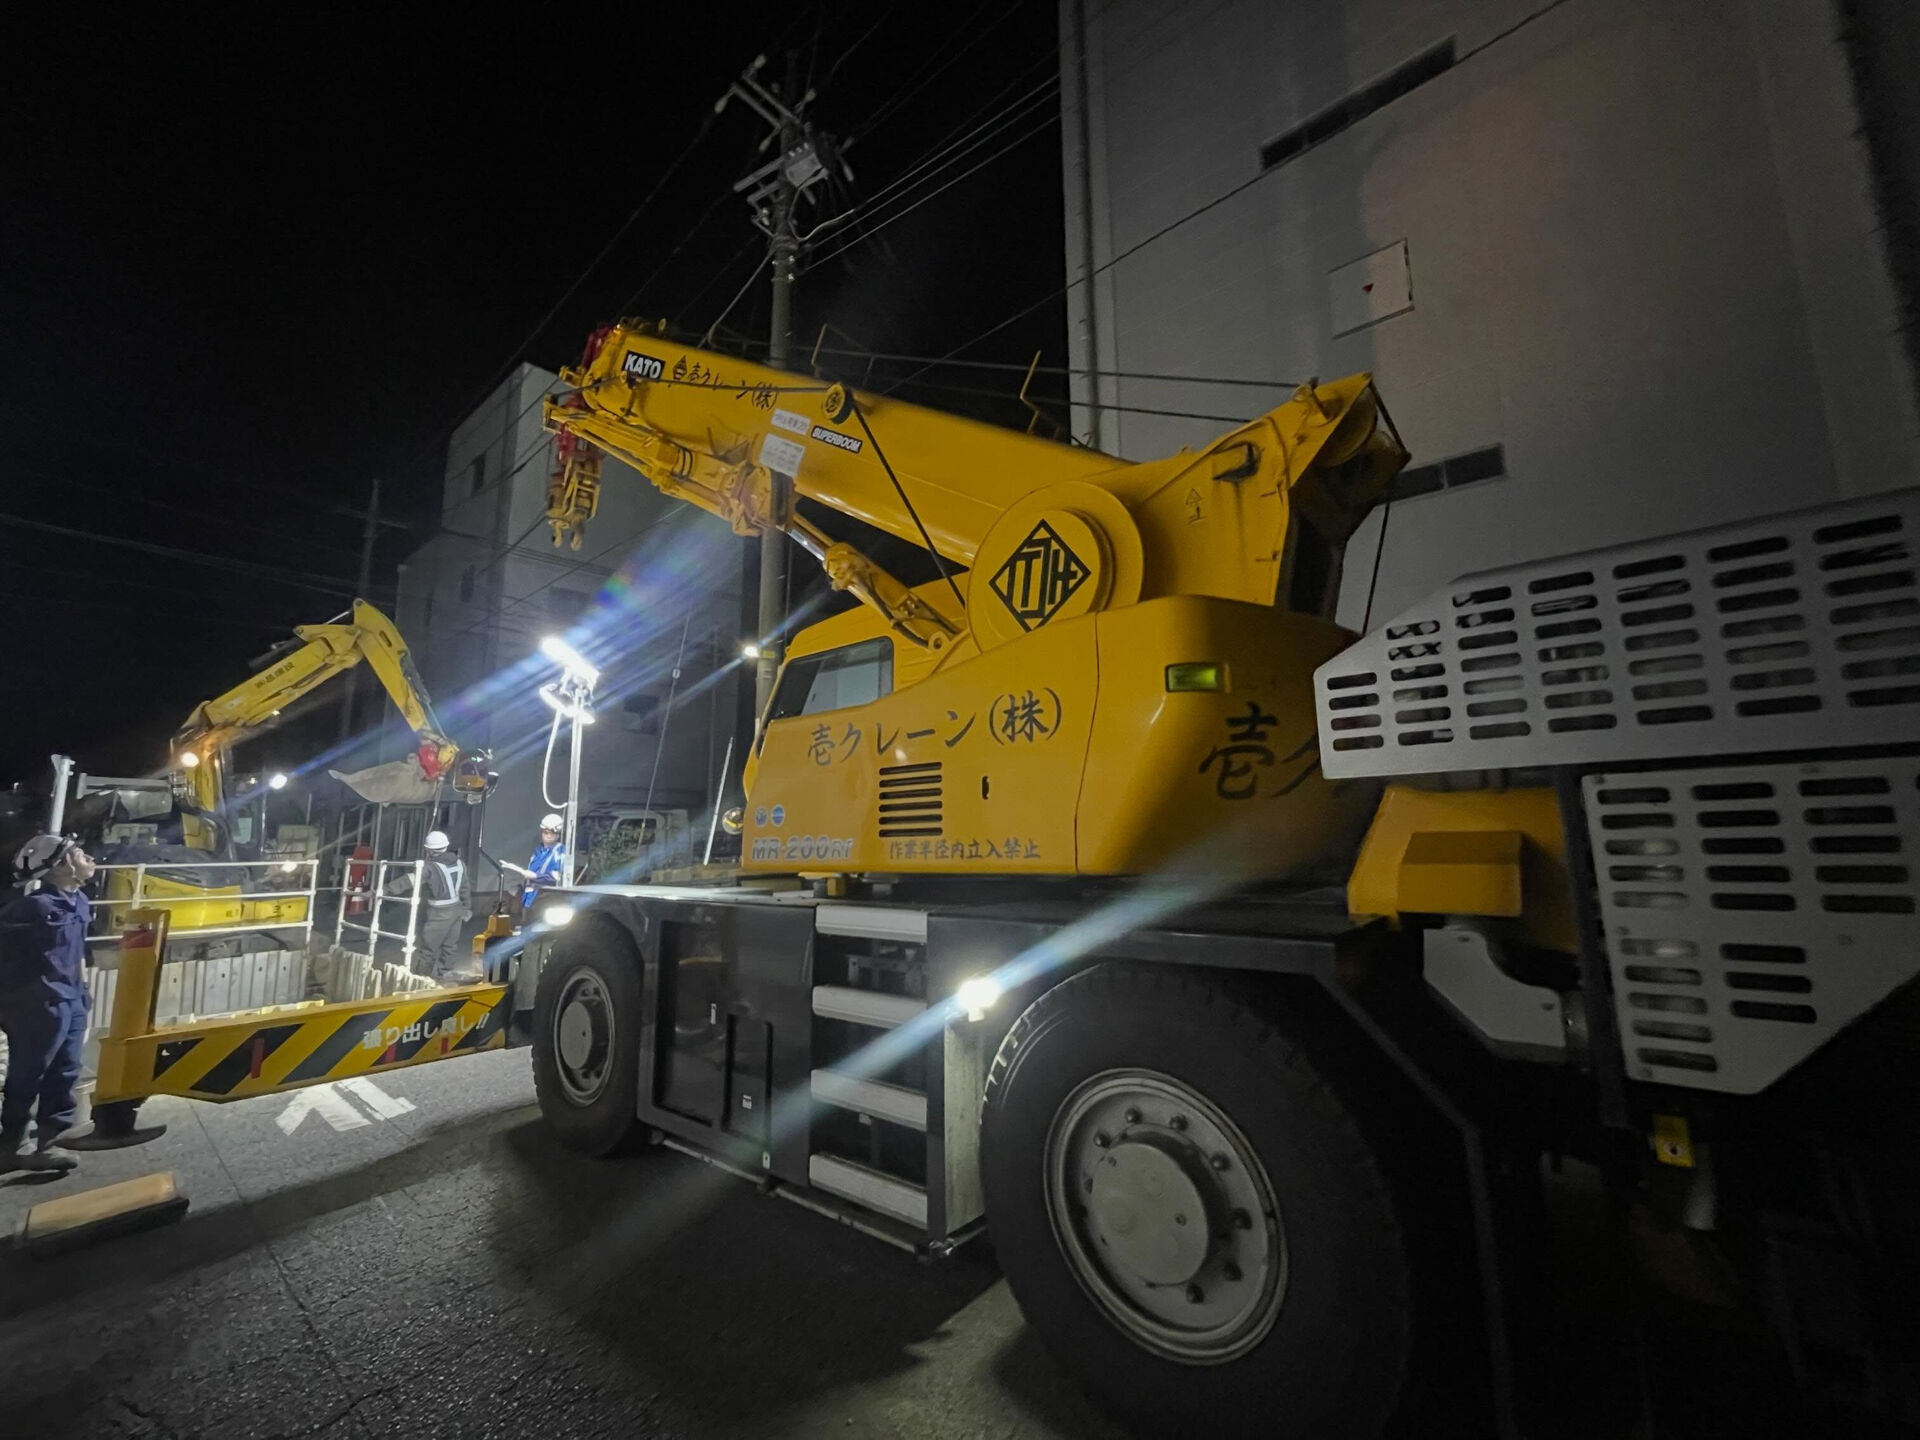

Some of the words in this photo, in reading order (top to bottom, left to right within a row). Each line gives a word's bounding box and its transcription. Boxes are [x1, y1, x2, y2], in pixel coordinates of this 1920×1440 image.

[624, 353, 662, 380] KATO
[812, 427, 861, 452] SUPERBOOM
[889, 837, 1041, 860] 作業半径内立入禁止
